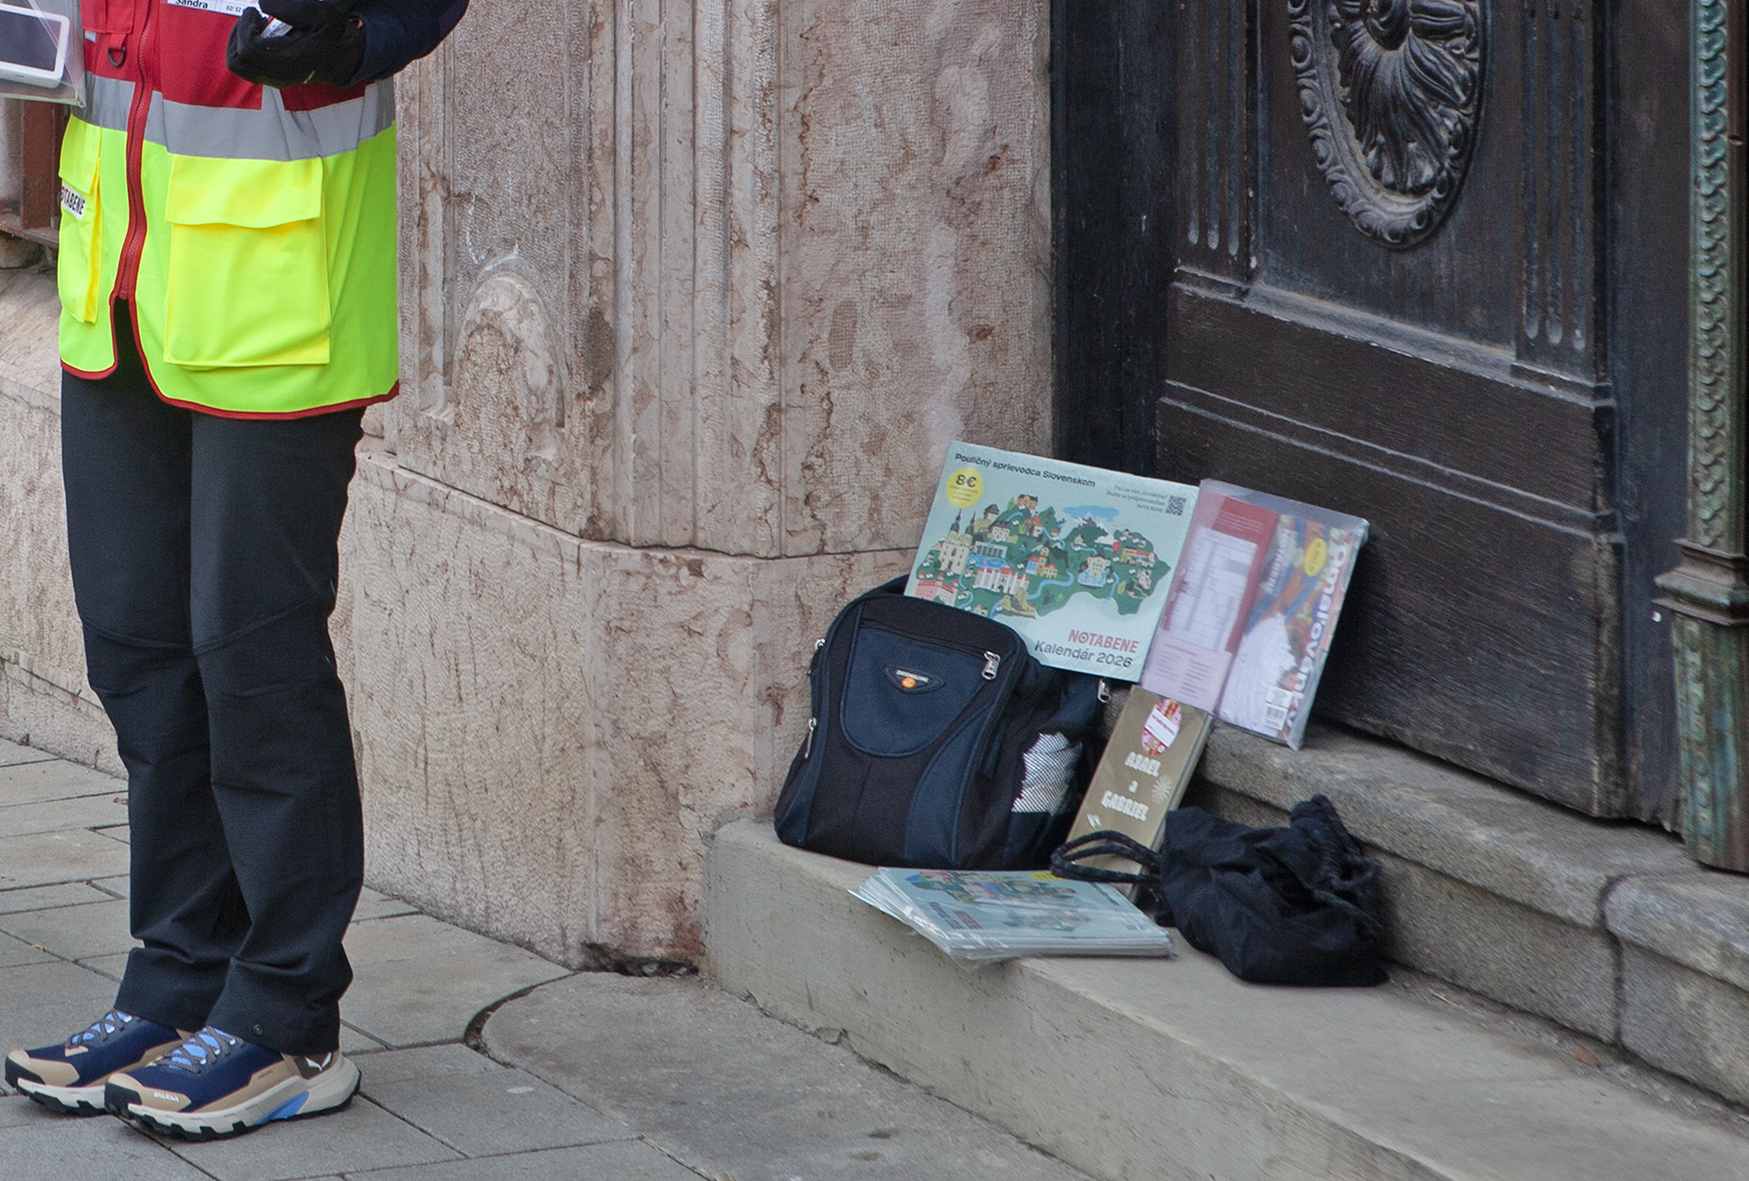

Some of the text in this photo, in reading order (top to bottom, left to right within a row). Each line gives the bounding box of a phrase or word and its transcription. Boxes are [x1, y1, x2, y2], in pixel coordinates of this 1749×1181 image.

[955, 453, 1095, 488] Pouličný sprievodca Slovenskom
[1034, 640, 1133, 668] Kalendár 2026
[1068, 629, 1139, 653] NOTABENE
